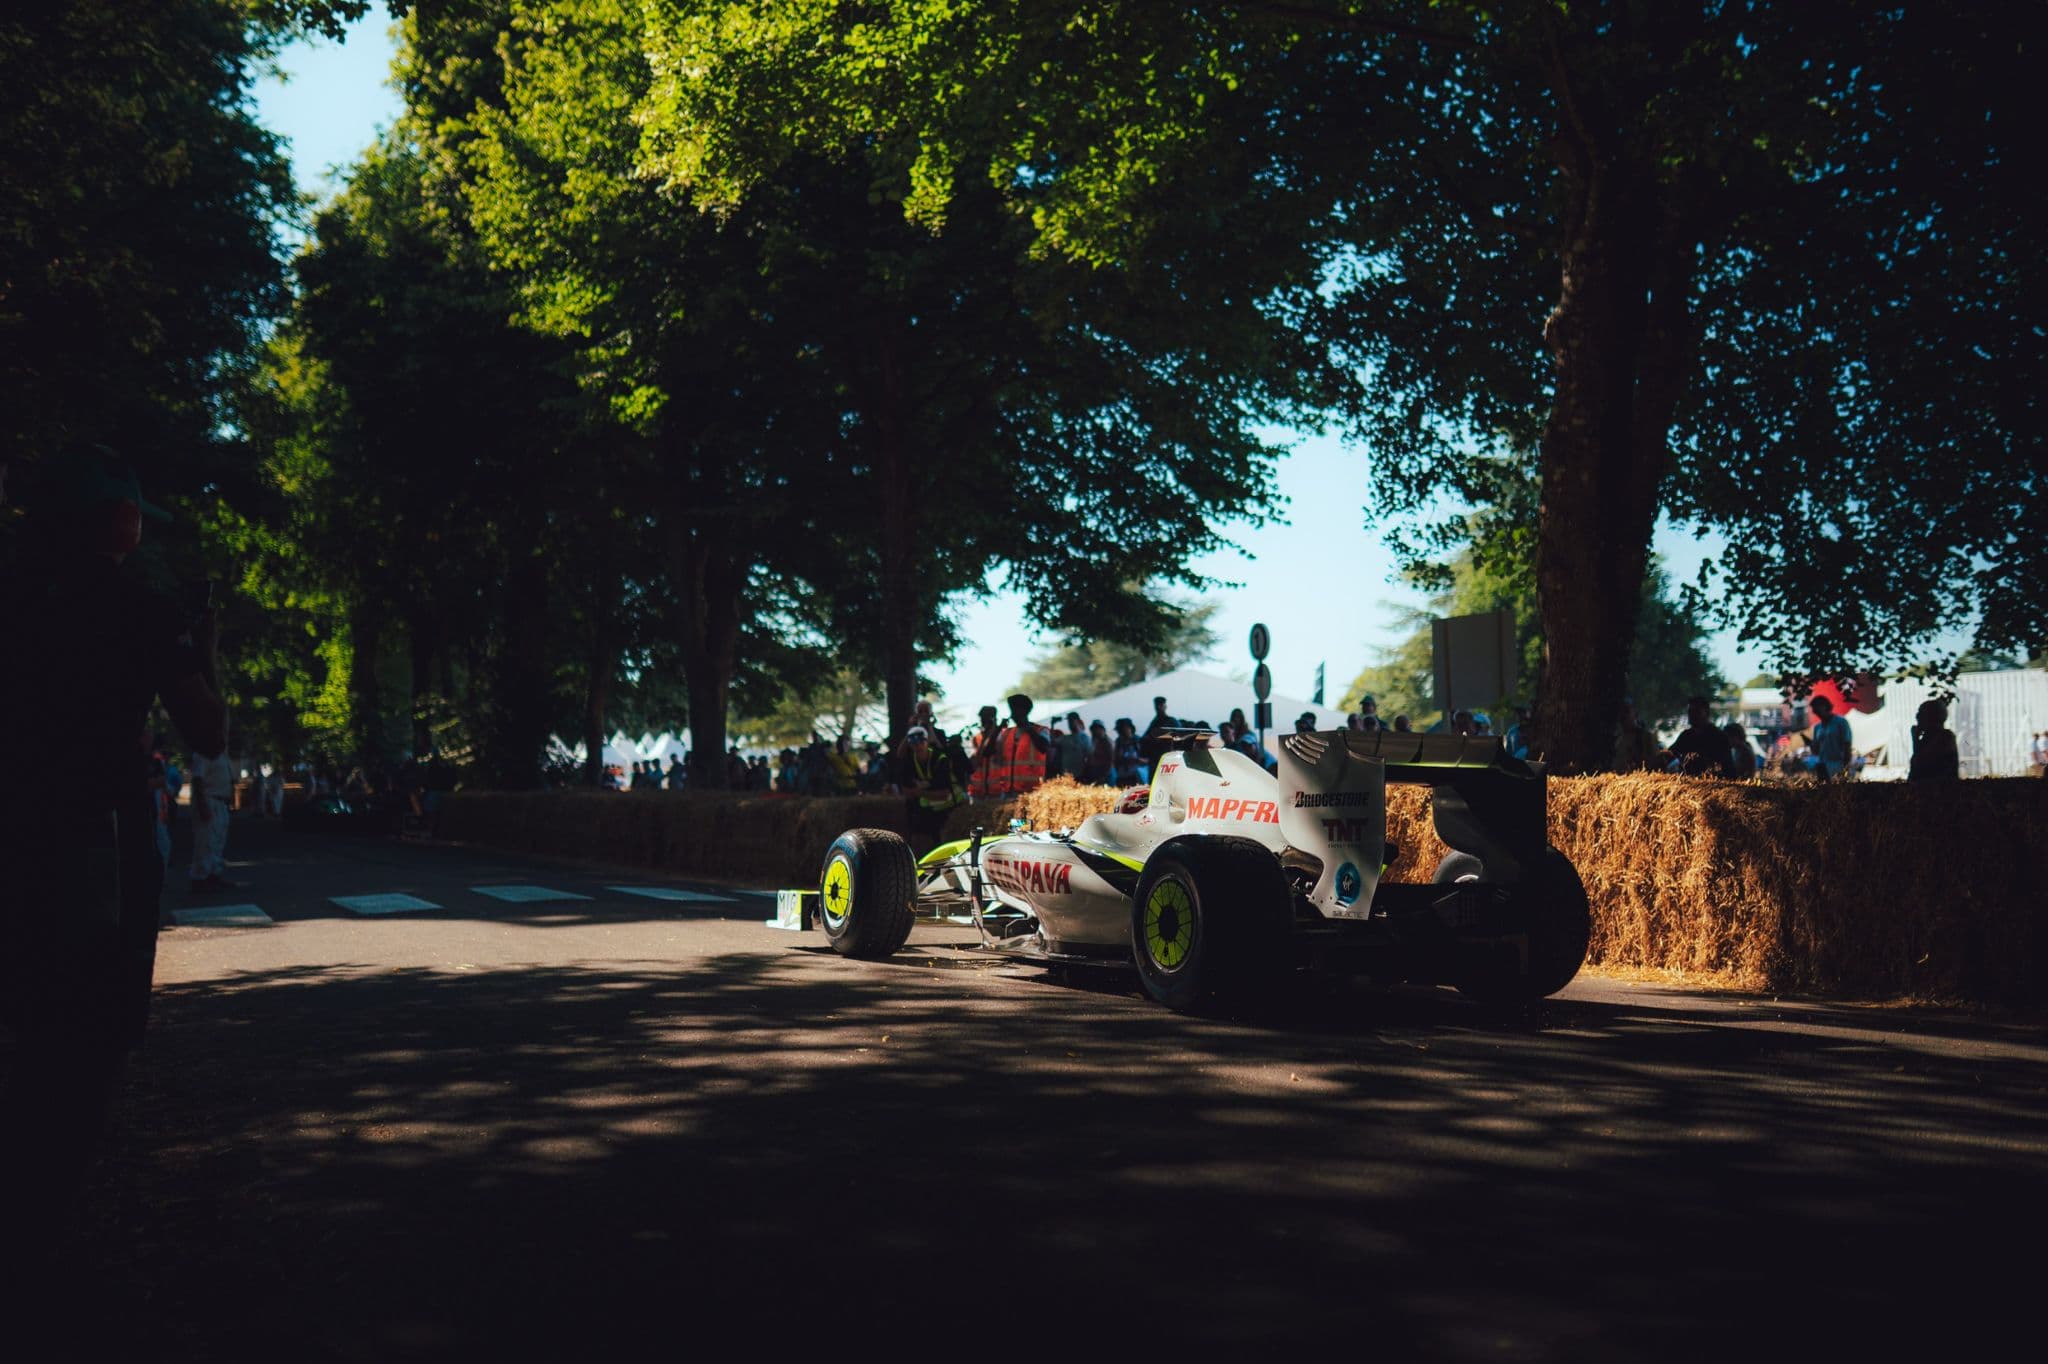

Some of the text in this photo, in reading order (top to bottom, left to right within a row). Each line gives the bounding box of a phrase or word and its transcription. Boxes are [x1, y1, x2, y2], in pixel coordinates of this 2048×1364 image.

[1160, 764, 1179, 774] TNT
[1295, 791, 1370, 808] BRIDGESTONE
[1187, 797, 1279, 823] MAPFR
[1321, 818, 1369, 841] TNT
